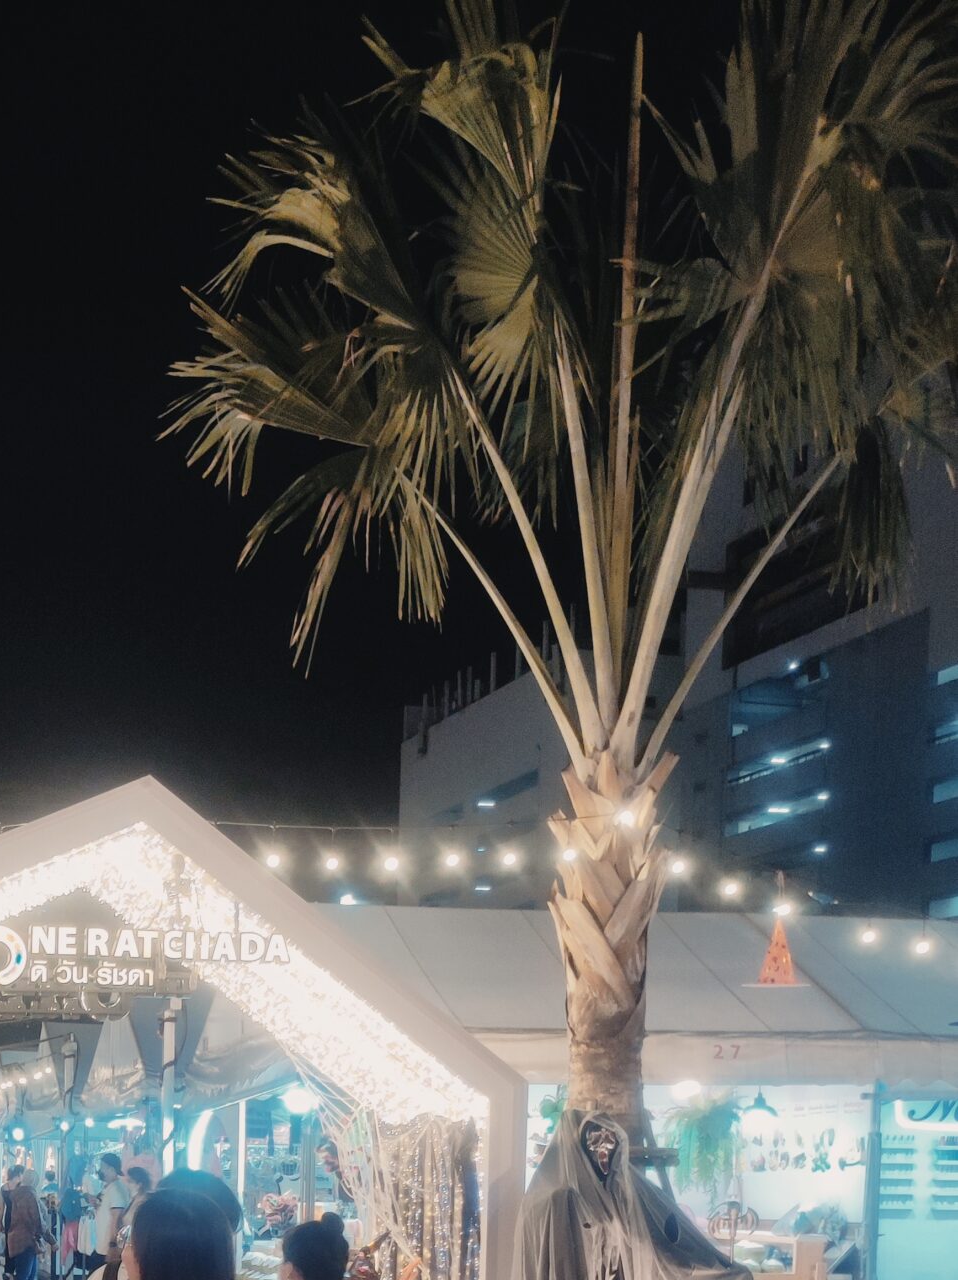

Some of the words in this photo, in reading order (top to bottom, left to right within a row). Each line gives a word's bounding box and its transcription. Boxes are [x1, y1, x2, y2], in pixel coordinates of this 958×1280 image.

[87, 927, 291, 963] RATCHADA
[30, 960, 48, 984] ดิ
[56, 960, 89, 985] วัน
[96, 961, 155, 987] รัชดา
